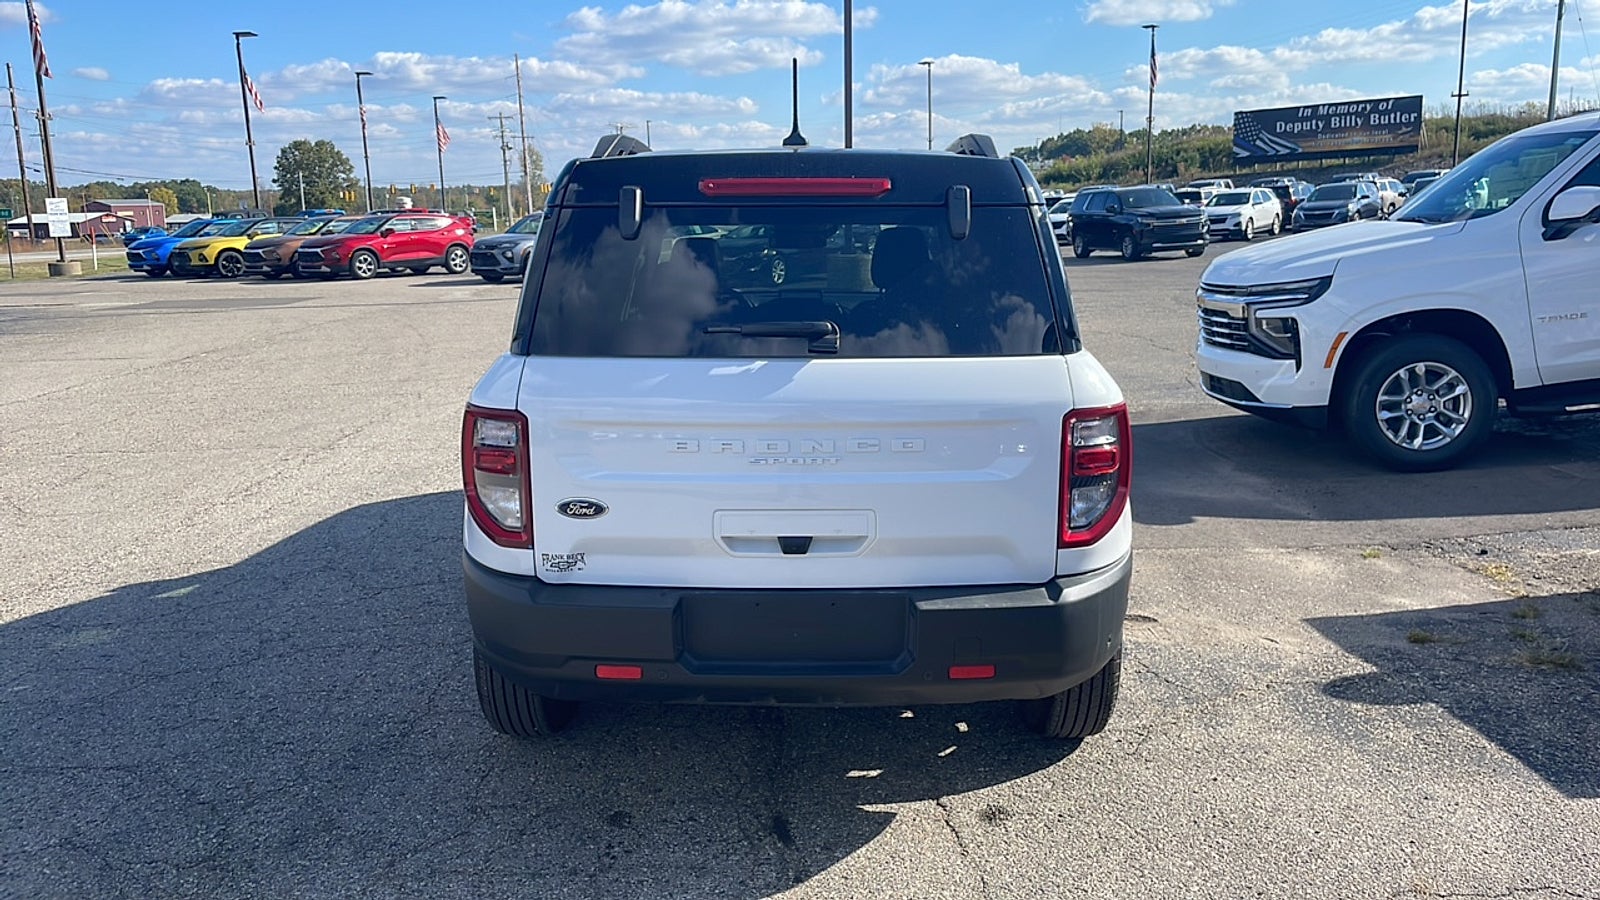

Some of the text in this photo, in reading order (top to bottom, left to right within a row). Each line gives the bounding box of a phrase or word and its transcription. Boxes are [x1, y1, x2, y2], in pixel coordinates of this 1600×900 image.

[1298, 99, 1395, 118] In Memory of
[1276, 112, 1417, 134] Deputy Billy Butler
[666, 438, 926, 454] BRONCO
[749, 457, 841, 465] SPORT
[566, 502, 596, 515] Ford
[541, 552, 587, 567] FRANK BECK
